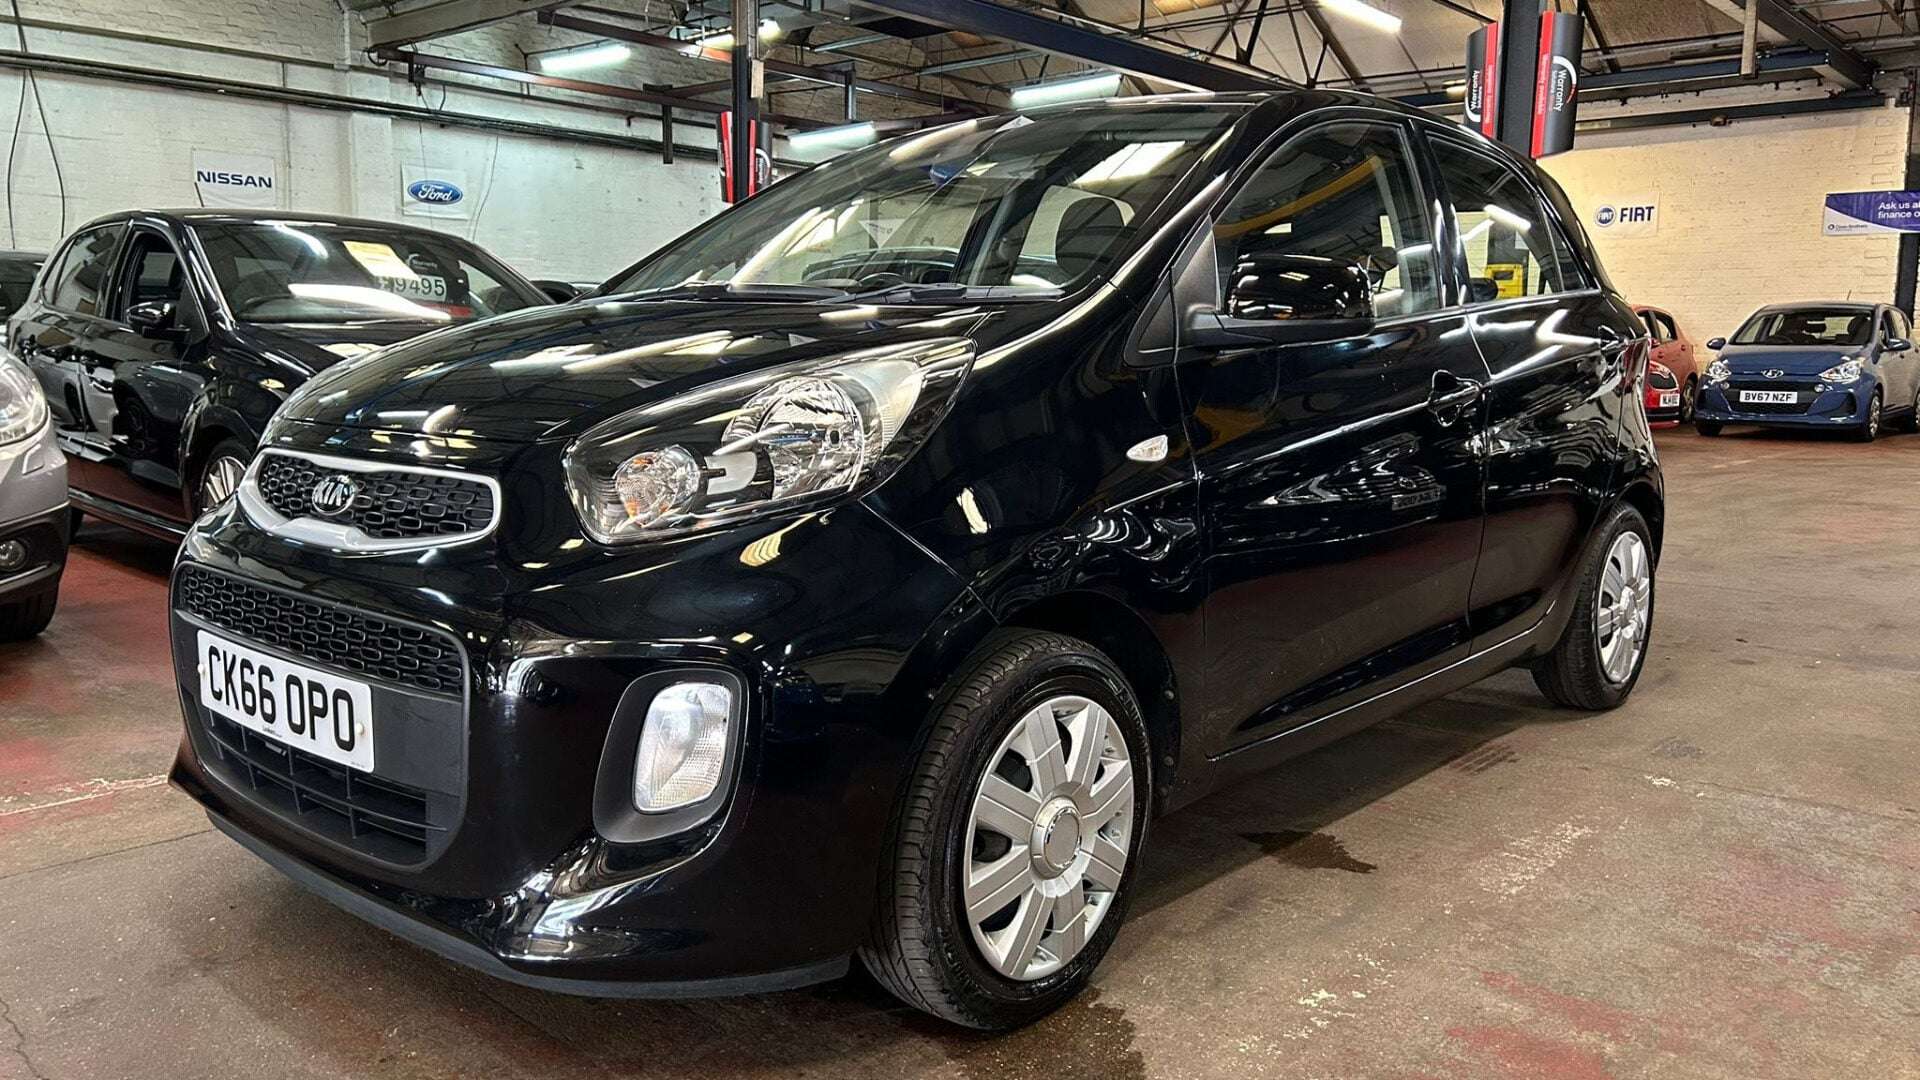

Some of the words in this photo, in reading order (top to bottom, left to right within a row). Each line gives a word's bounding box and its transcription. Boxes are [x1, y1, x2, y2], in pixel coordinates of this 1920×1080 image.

[1553, 69, 1567, 112] Warranty
[197, 170, 272, 189] NISSAN
[418, 184, 453, 201] Ford
[1619, 206, 1655, 223] FIAT
[1878, 202, 1897, 210] Ask
[1878, 210, 1912, 219] finance
[1744, 392, 1770, 401] BV67
[1772, 392, 1793, 402] NZF
[314, 480, 345, 507] KIA
[208, 645, 276, 725] CK66
[285, 673, 356, 752] OPO
